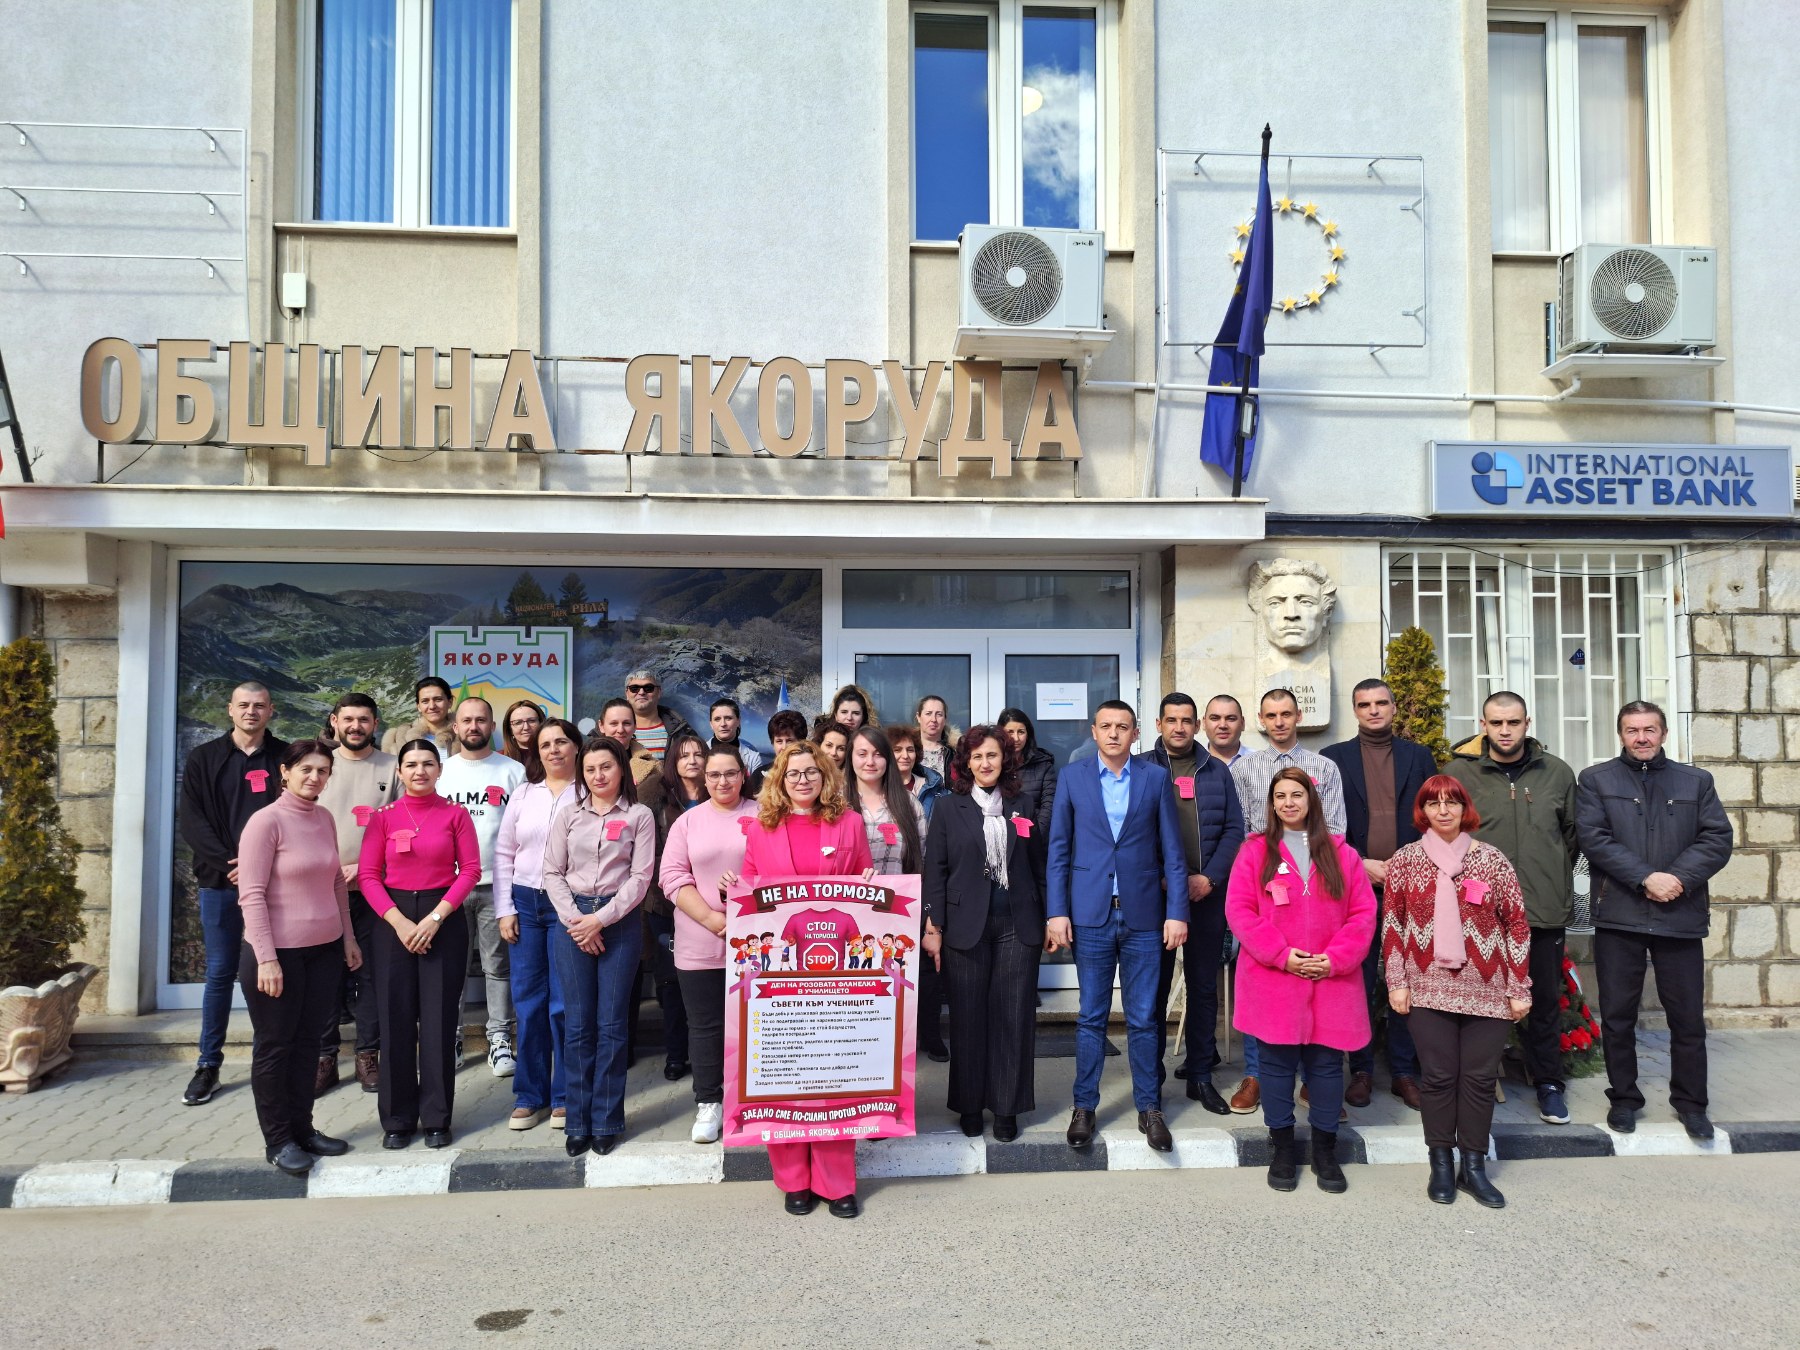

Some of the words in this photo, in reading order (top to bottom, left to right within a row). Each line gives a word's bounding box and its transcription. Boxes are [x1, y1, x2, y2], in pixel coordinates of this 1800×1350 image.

[80, 337, 558, 467] ОБЩИНА
[621, 353, 1084, 477] ЯКОРУДА
[1527, 453, 1754, 477] INTERNATIONAL
[1525, 476, 1643, 505] ASSET
[1652, 478, 1758, 507] BANK
[571, 602, 606, 614] РИЛА
[443, 652, 560, 668] ЯКОРУДА
[1296, 695, 1316, 704] СКИ
[446, 791, 510, 806] ALMAN
[761, 887, 783, 903] НЕ
[786, 885, 809, 899] НА
[812, 883, 886, 903] ТОРМОЗА
[806, 921, 837, 932] СТОП
[807, 955, 835, 965] STOP
[771, 1000, 803, 1008] СЪВЕТИ
[827, 999, 875, 1007] УЧЕНИЦИТЕ
[742, 1107, 774, 1121] ЗАЕДНО
[775, 1109, 791, 1120] СМЕ
[792, 1111, 828, 1122] ПО-СИЛНИ
[829, 1106, 857, 1121] ПРОТИВ
[857, 1101, 897, 1116] ТОРМОЗА!
[773, 1129, 806, 1139] ОБЩИНА
[808, 1127, 840, 1137] ЯКОРУДА
